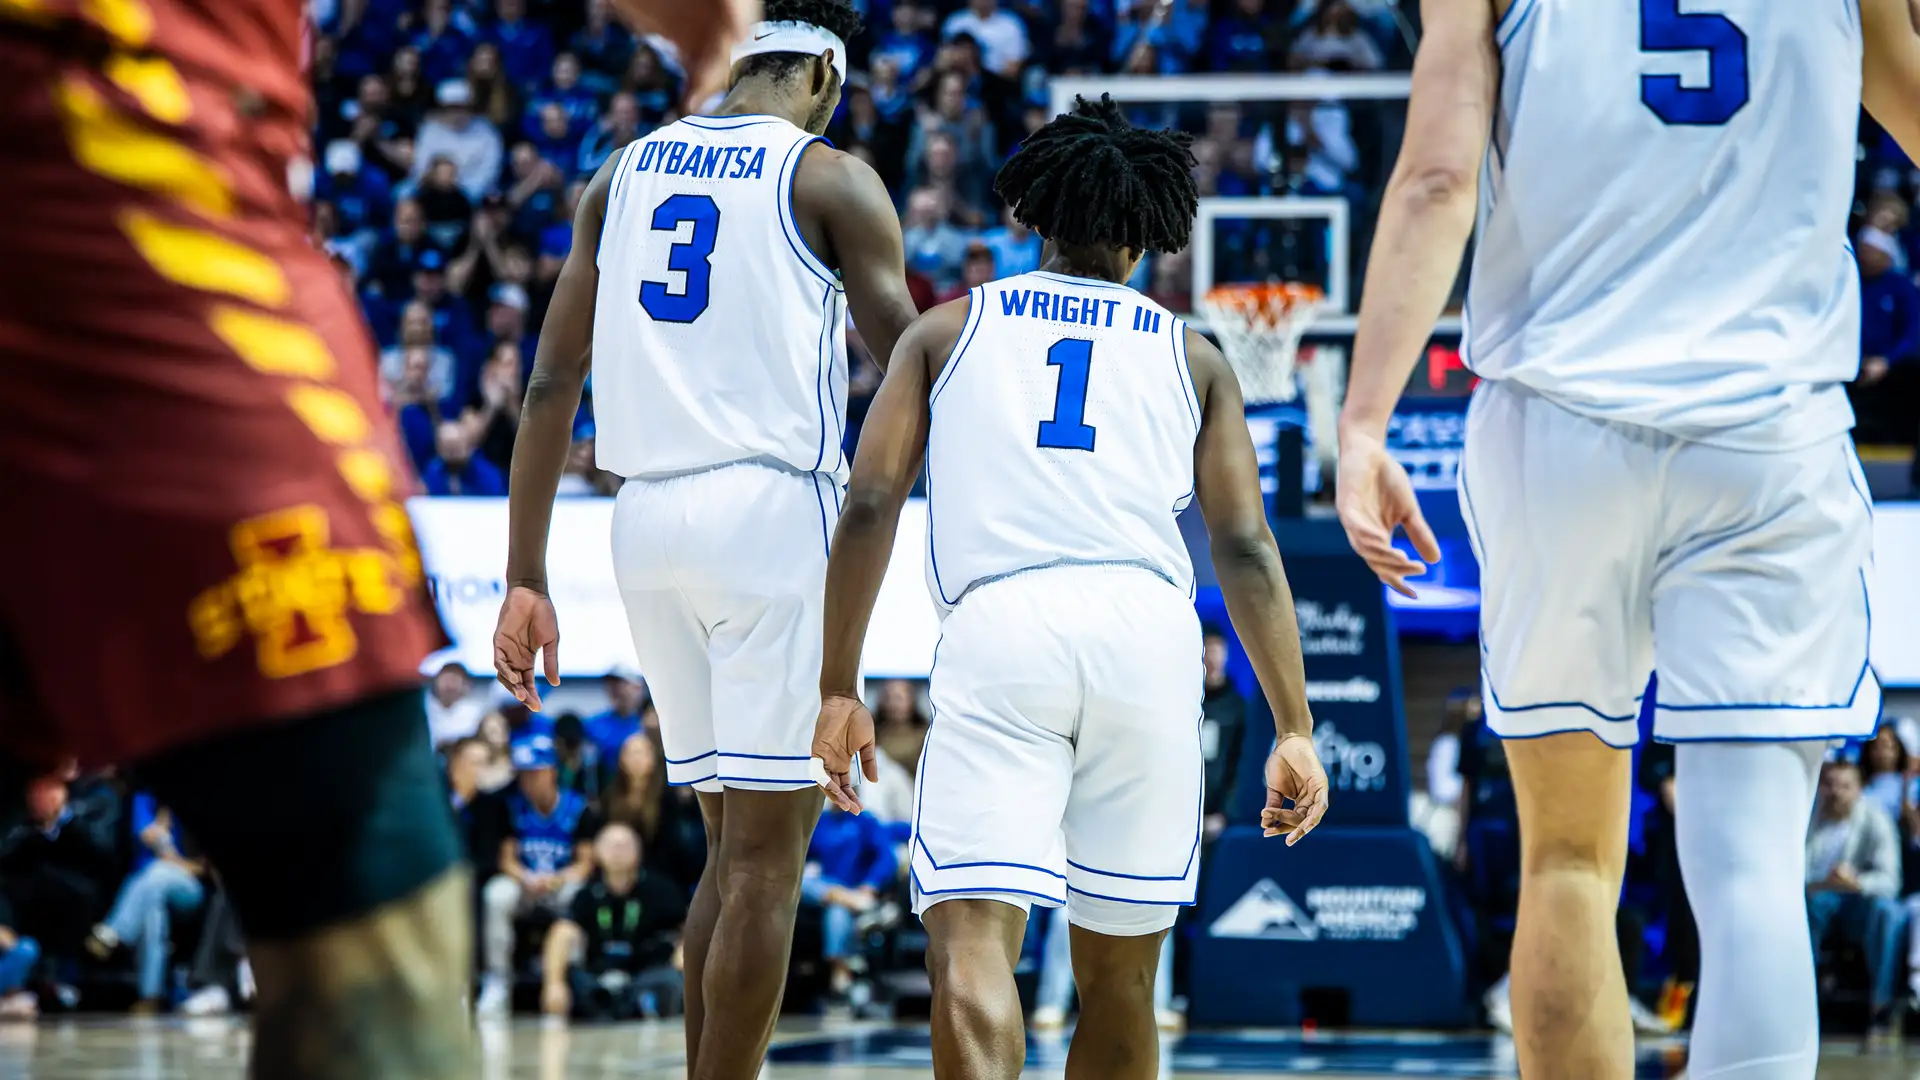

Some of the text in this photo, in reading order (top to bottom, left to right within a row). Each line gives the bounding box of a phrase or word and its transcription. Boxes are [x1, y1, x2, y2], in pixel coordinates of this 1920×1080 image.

[1639, 0, 1750, 125] 5
[636, 141, 766, 179] DYBANTSA
[639, 193, 721, 323] 3
[1000, 289, 1161, 334] WRIGHT III
[1037, 337, 1096, 452] 1
